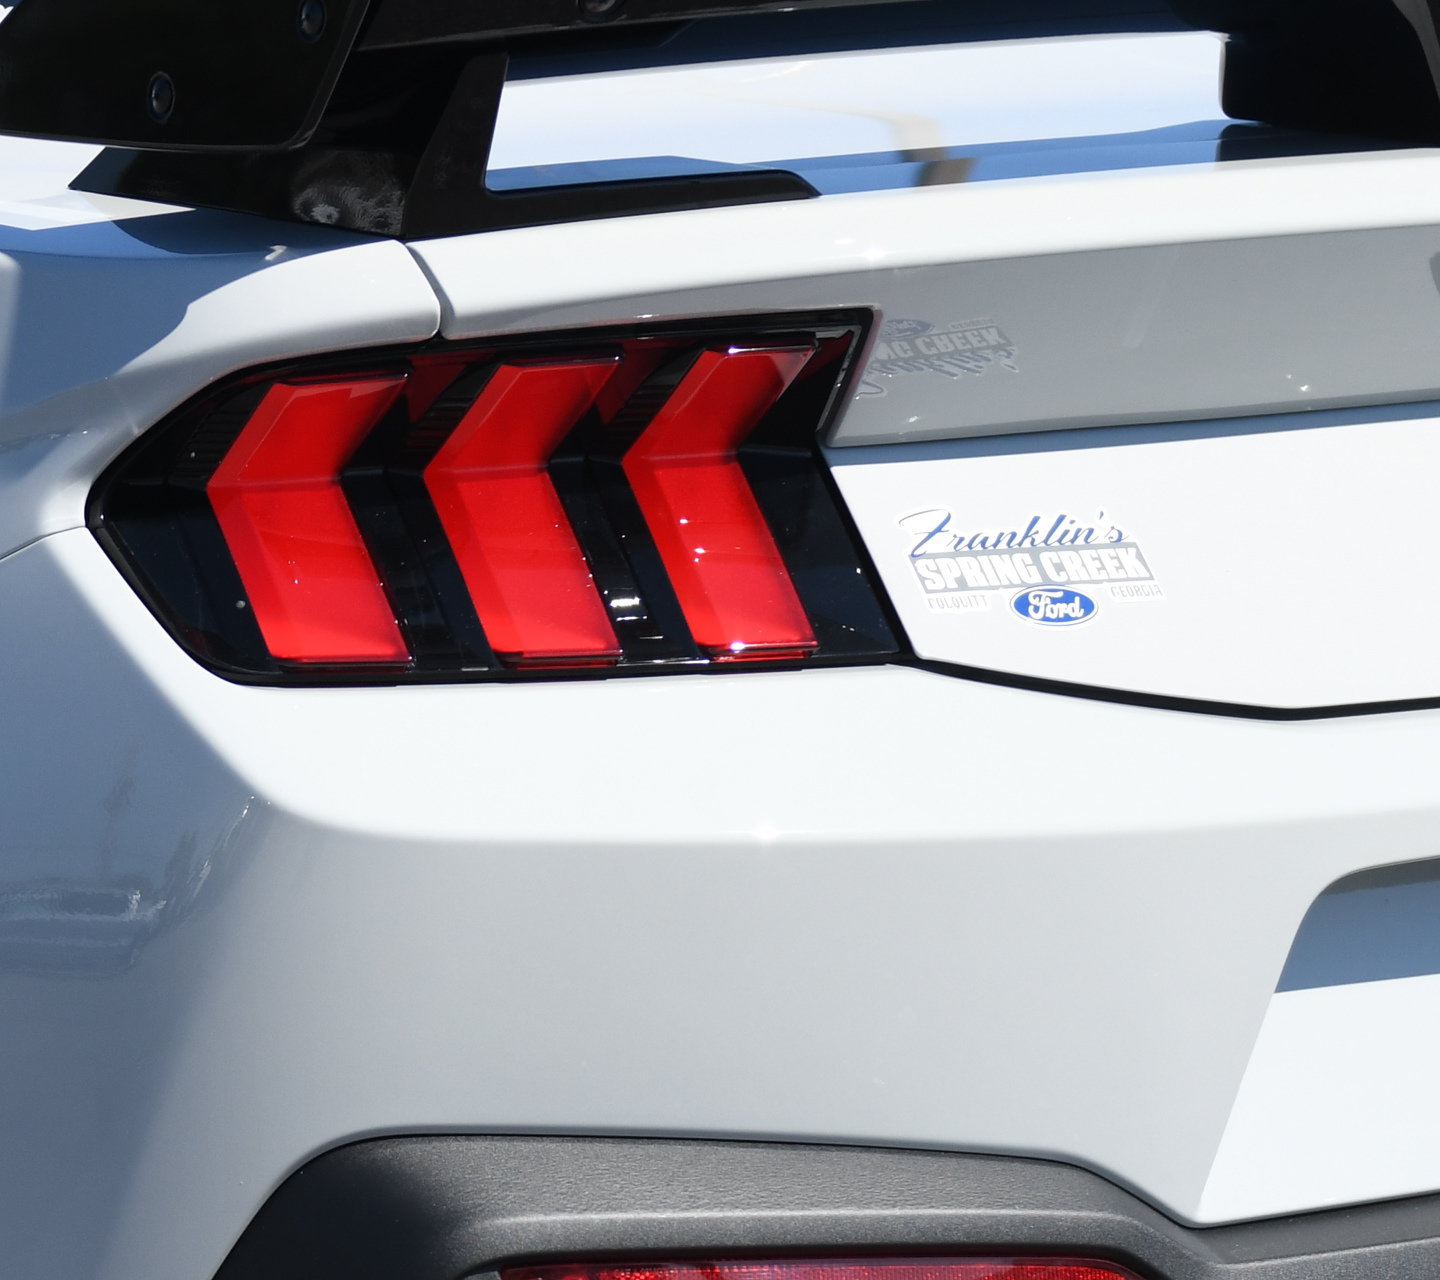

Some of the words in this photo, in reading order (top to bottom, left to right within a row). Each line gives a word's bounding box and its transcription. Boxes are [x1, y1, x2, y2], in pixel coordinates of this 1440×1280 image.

[898, 509, 1129, 558] Franklin's
[914, 552, 1043, 591] SPRING
[1039, 547, 1151, 583] CREEK
[1028, 591, 1085, 620] Ford
[1110, 584, 1164, 598] GEORGIA
